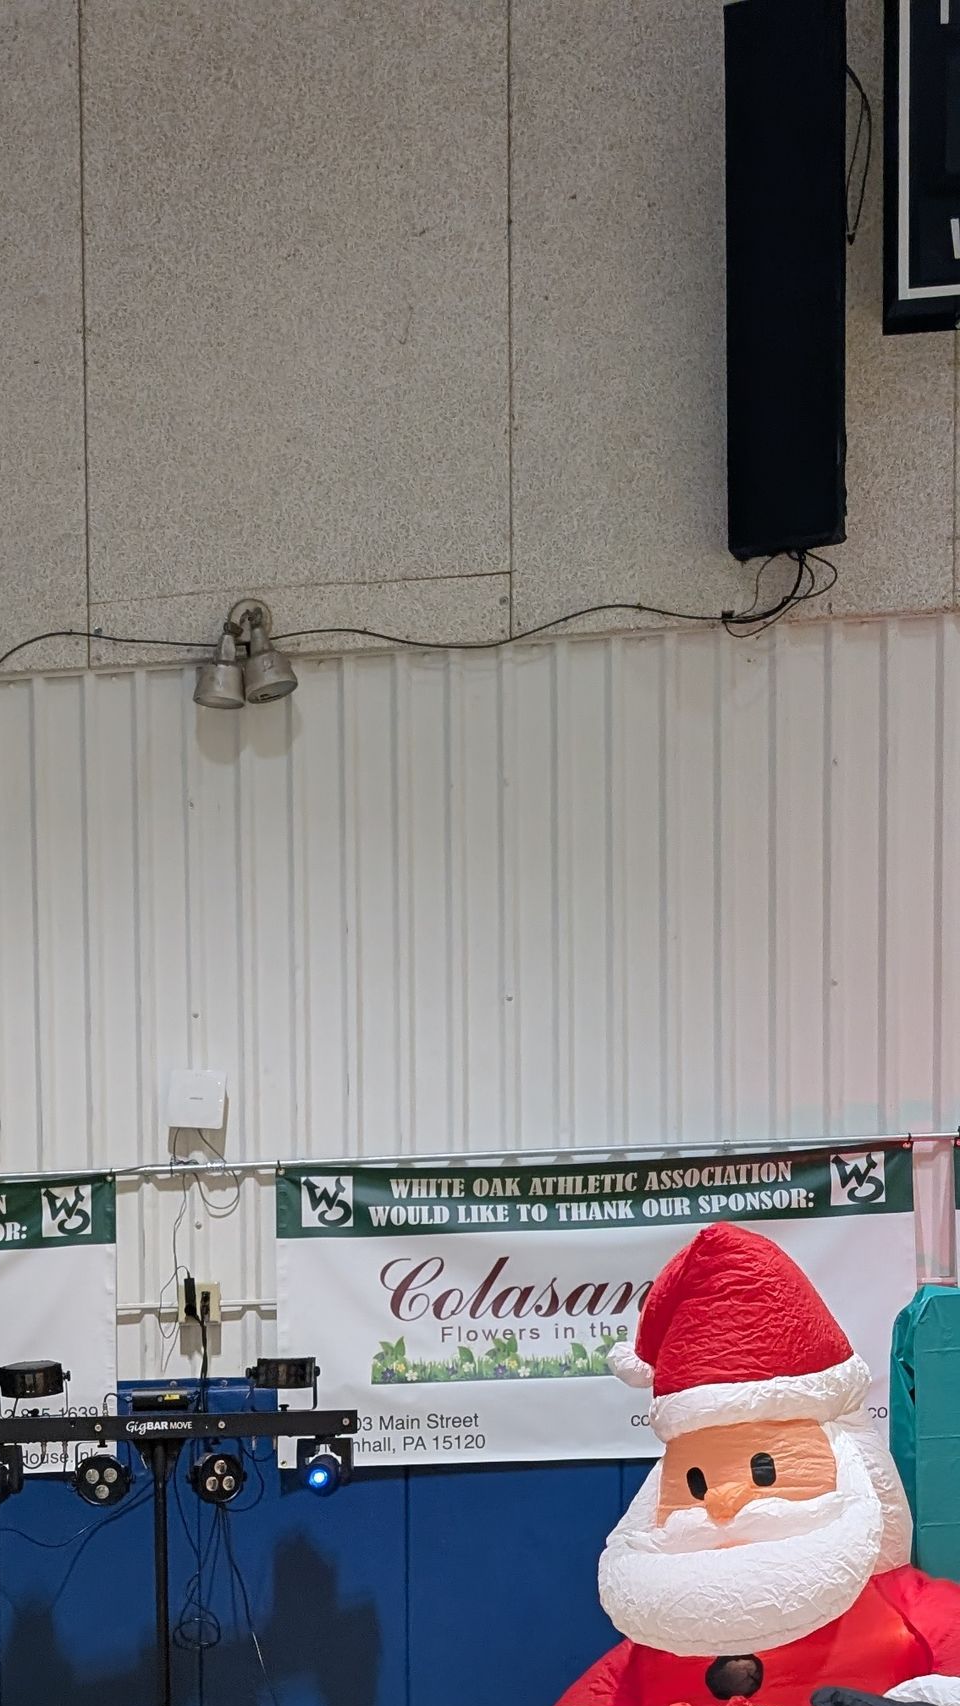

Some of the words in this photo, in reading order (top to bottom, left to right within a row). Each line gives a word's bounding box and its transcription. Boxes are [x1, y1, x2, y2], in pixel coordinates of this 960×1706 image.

[389, 1177, 465, 1200] WHITE
[472, 1176, 522, 1198] OAK
[528, 1171, 638, 1197] ATHLETIC
[644, 1160, 793, 1192] ASSOCIATION
[368, 1203, 451, 1228] WOULD
[457, 1203, 510, 1225] LIKE
[516, 1203, 548, 1223] TO
[555, 1199, 635, 1222] THANK
[642, 1196, 692, 1219] OUR
[698, 1188, 815, 1215] SPONSOR:
[441, 1326, 540, 1343] Flowers
[555, 1323, 575, 1340] in
[590, 1322, 628, 1339] the
[126, 1420, 169, 1435] GigBAR
[170, 1421, 193, 1430] MOVE
[379, 1414, 420, 1431] Main
[427, 1413, 480, 1429] Street
[403, 1436, 427, 1452] PA
[433, 1434, 486, 1451] 15120
